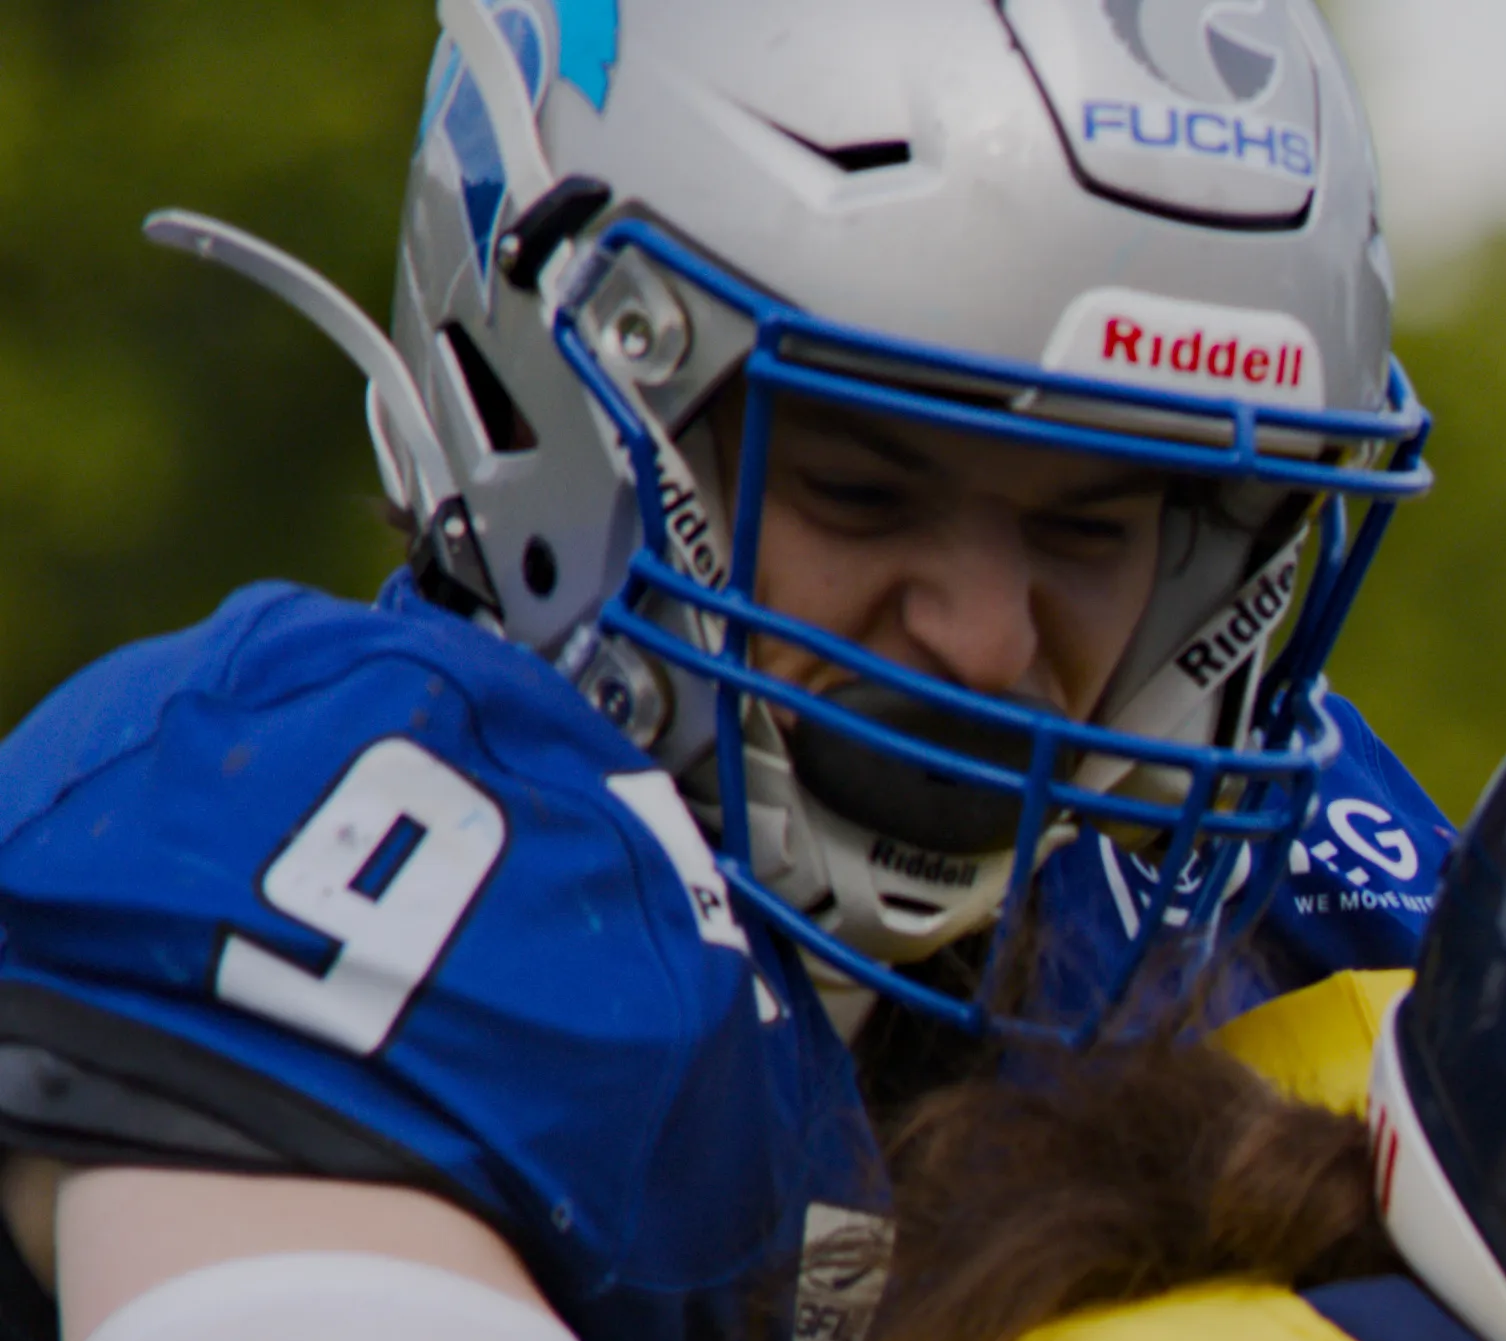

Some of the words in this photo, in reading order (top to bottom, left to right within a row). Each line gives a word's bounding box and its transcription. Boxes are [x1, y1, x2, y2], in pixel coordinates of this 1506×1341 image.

[1081, 102, 1313, 177] FUCHS
[1102, 316, 1304, 389] Riddell
[215, 735, 508, 1057] 9
[1294, 894, 1330, 915] WE
